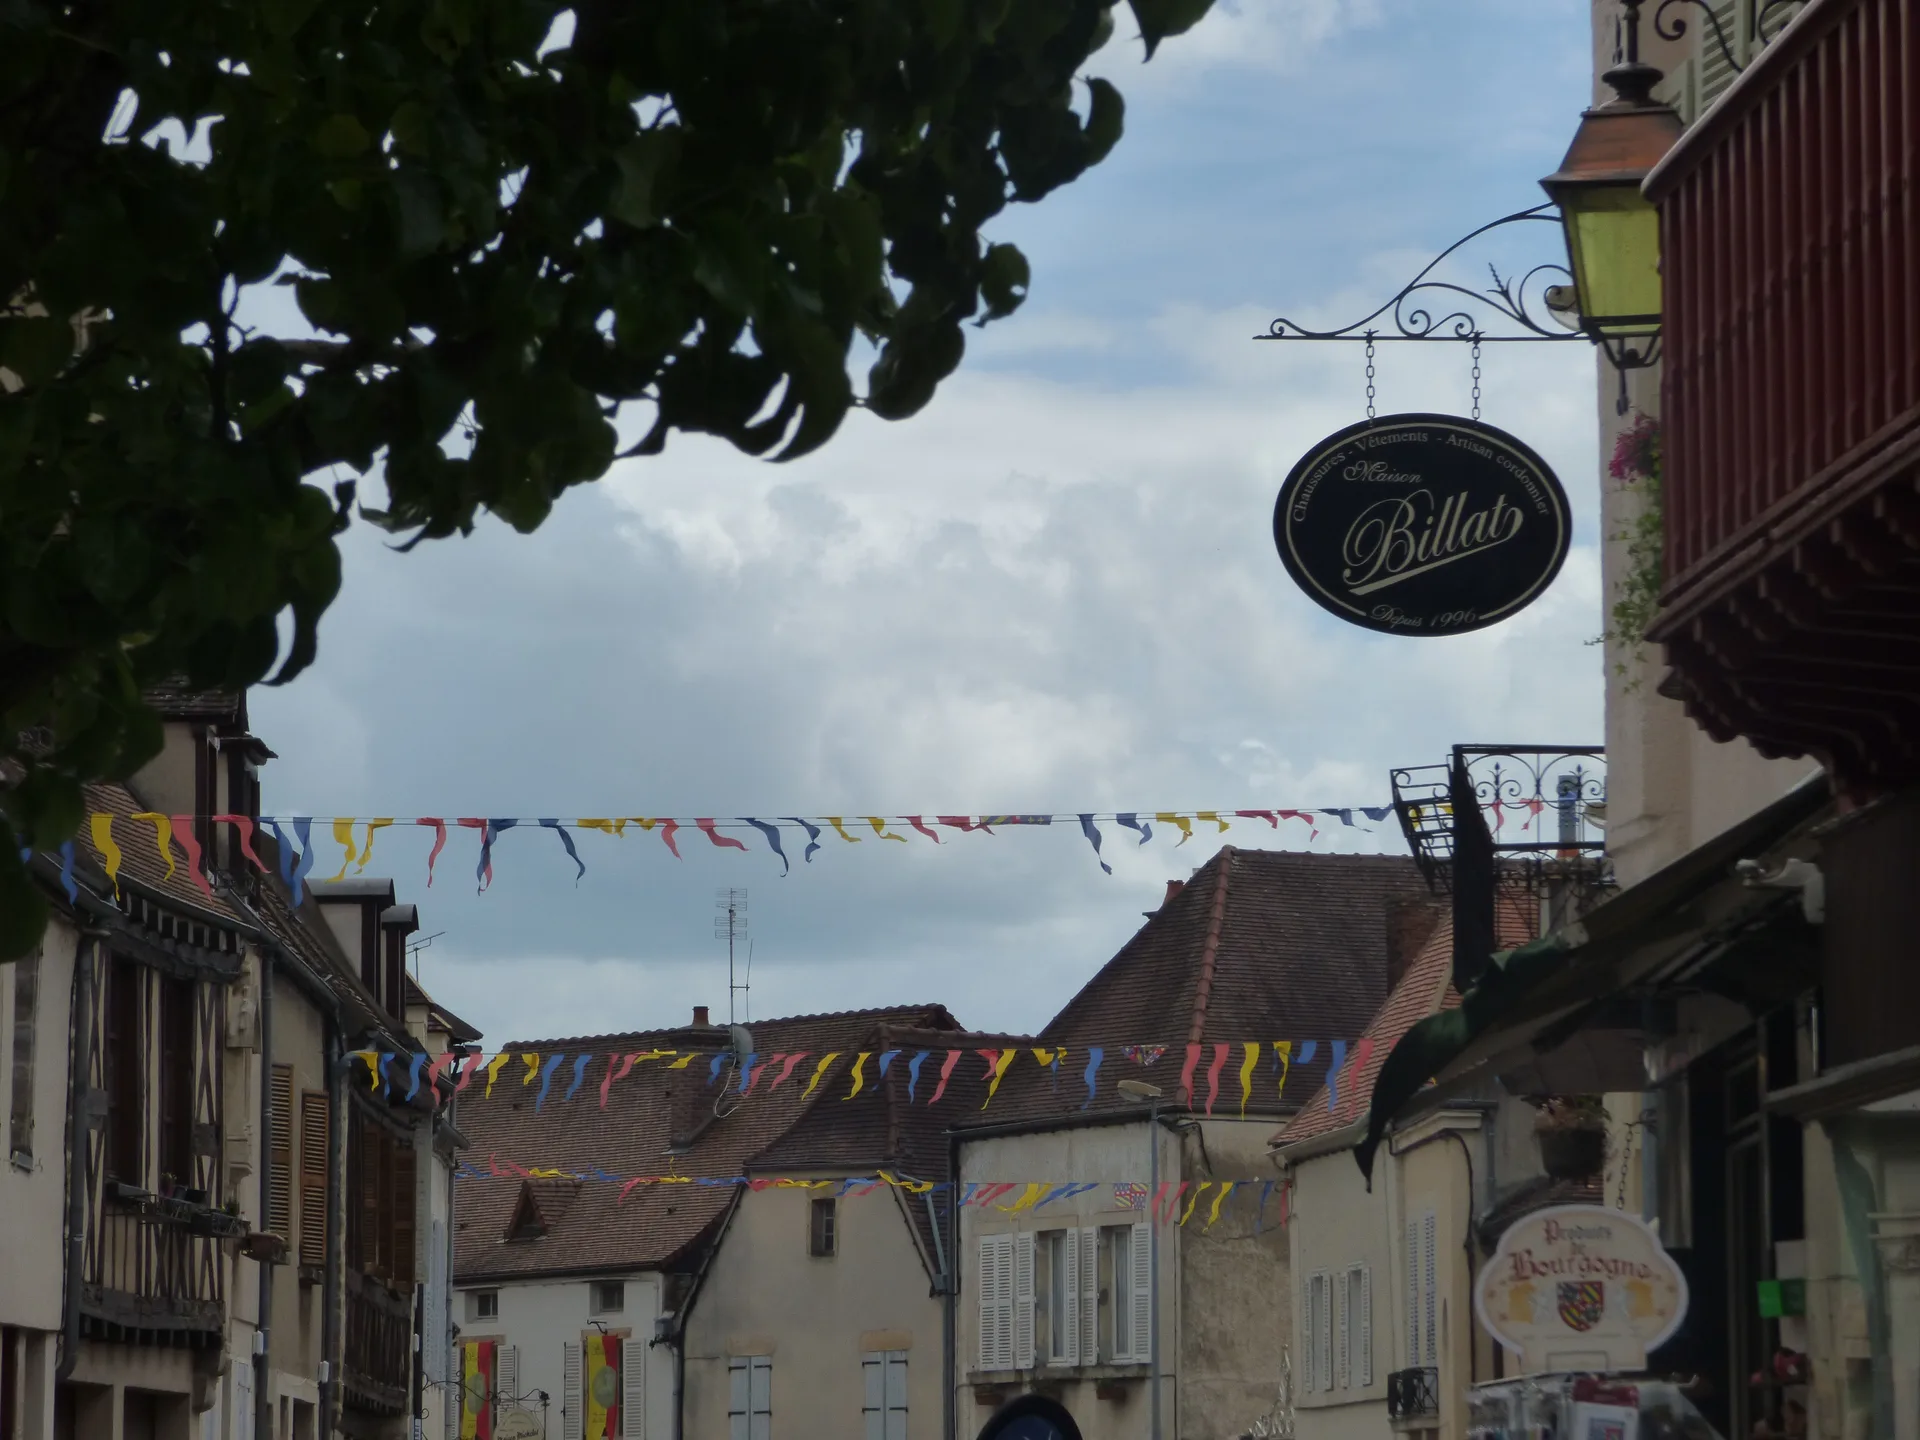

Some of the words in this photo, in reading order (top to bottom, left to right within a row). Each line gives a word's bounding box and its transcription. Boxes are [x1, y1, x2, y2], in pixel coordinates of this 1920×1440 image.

[1293, 451, 1346, 523] Chaussures
[1354, 431, 1429, 452] Vêtements
[1446, 433, 1493, 460] Artisan
[1496, 454, 1550, 517] cordonnier
[1342, 459, 1424, 483] Maison
[1342, 488, 1524, 592] Billat
[1371, 604, 1423, 629] Depuis
[1429, 607, 1476, 628] 1996
[1508, 1248, 1656, 1281] Bourgogne
